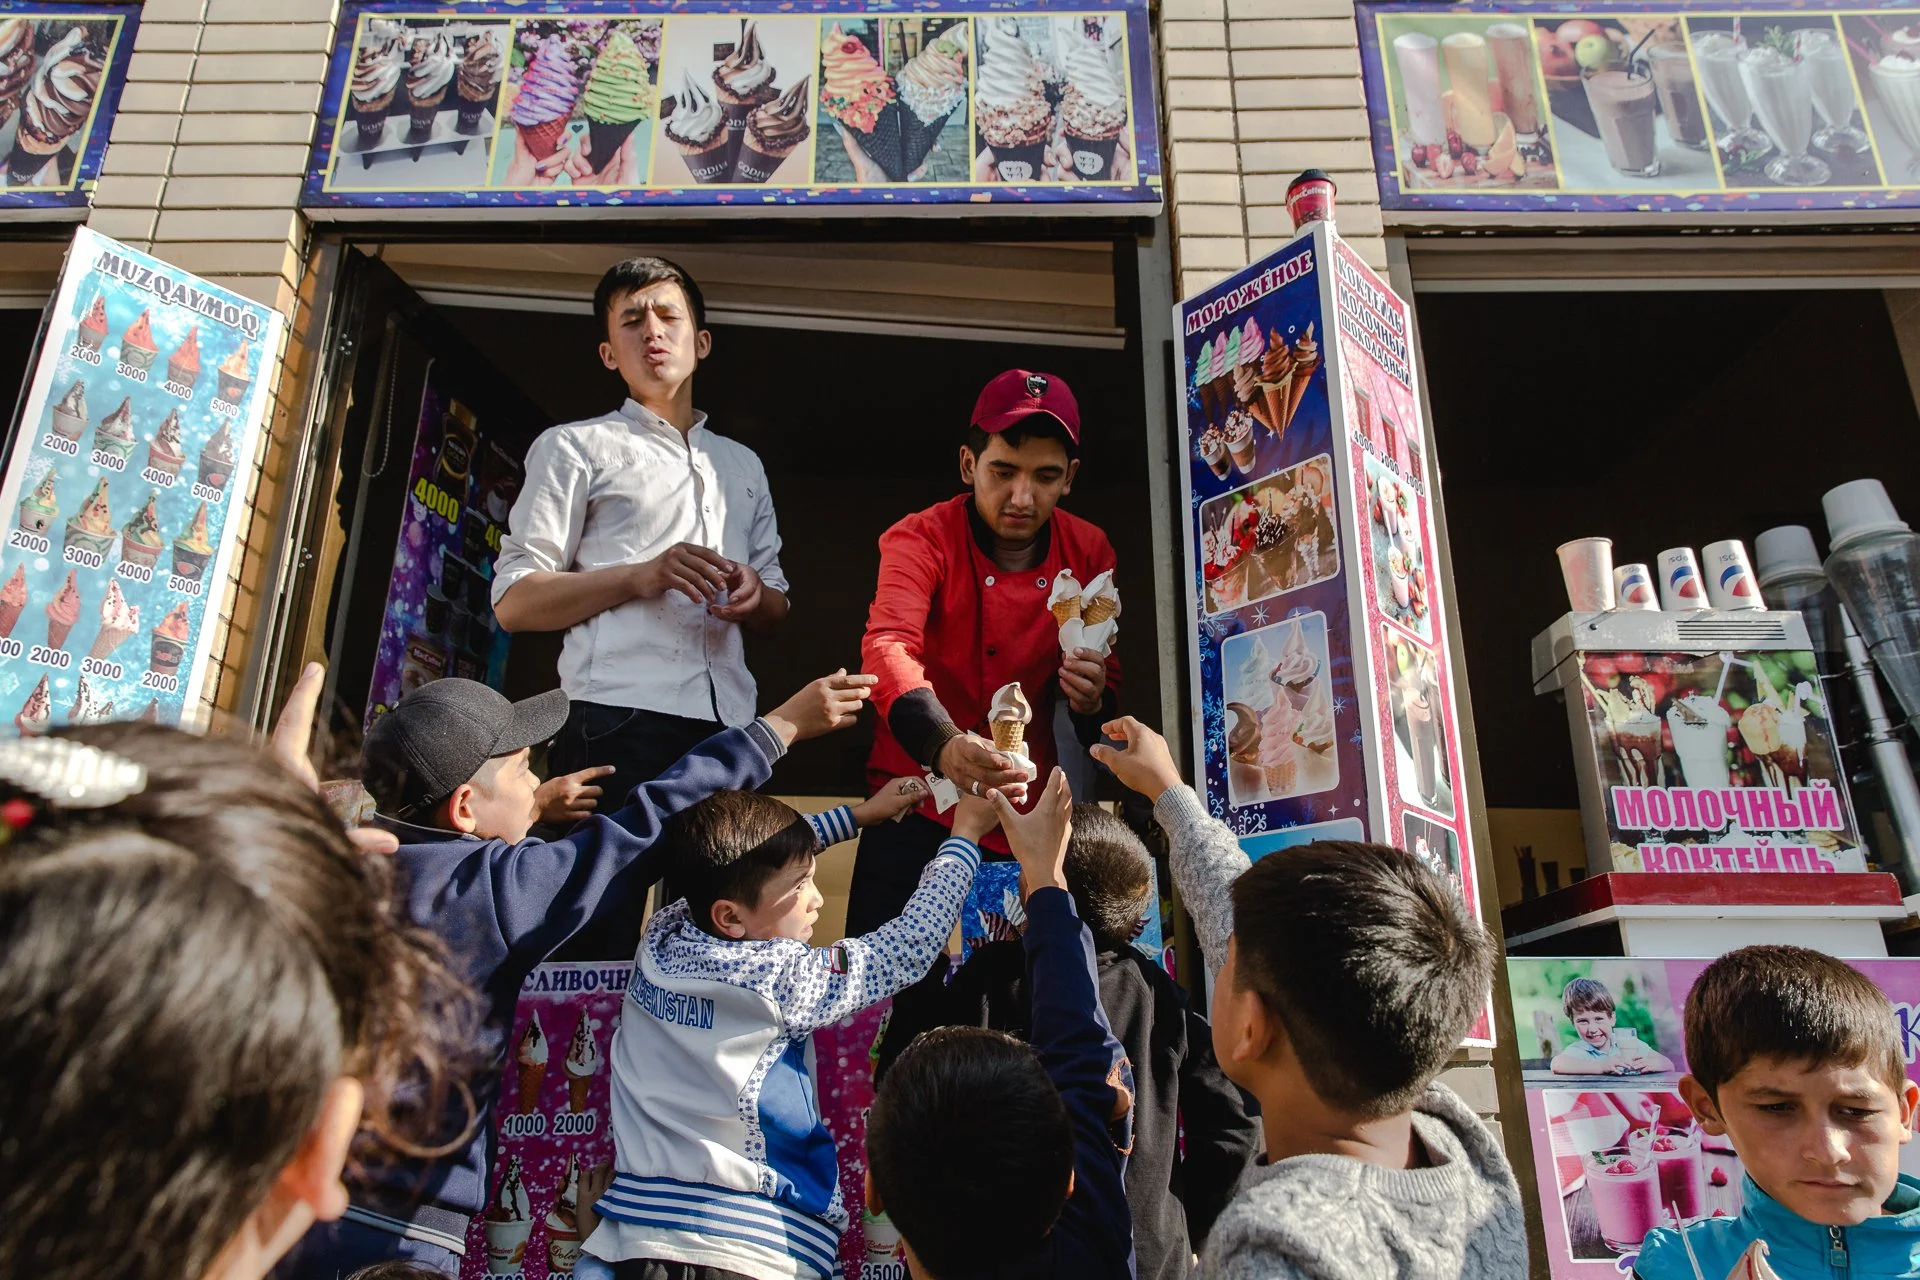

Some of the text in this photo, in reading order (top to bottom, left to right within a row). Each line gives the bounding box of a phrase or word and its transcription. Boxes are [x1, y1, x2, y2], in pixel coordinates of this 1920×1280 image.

[97, 251, 261, 337] MUZQAYMOQ
[1337, 256, 1403, 334] КОКТЕЙЛЬ
[1340, 285, 1406, 361] МОЛОЧНЫЙ
[1340, 311, 1410, 386] ШОКОЛАДНЫЙ
[71, 345, 238, 417] 2000 3000 4000 5000
[44, 435, 221, 502] 2000 3000 4000 5000
[1354, 430, 1374, 455] 4000
[1405, 472, 1423, 495] 2000
[414, 477, 459, 524] 4000
[10, 532, 200, 595] 2000 3000 4000 5000
[485, 523, 501, 553] 40
[0, 639, 177, 691] 00 2000 3000 2000
[1613, 779, 1841, 830] МОЛОЧНЫЙ
[1639, 840, 1836, 873] КОКТЕЙЛЬ
[522, 969, 631, 992] СЛИВОЧН
[506, 1116, 544, 1134] 1000
[555, 1115, 595, 1134] 2000
[862, 1264, 903, 1280] 3500
